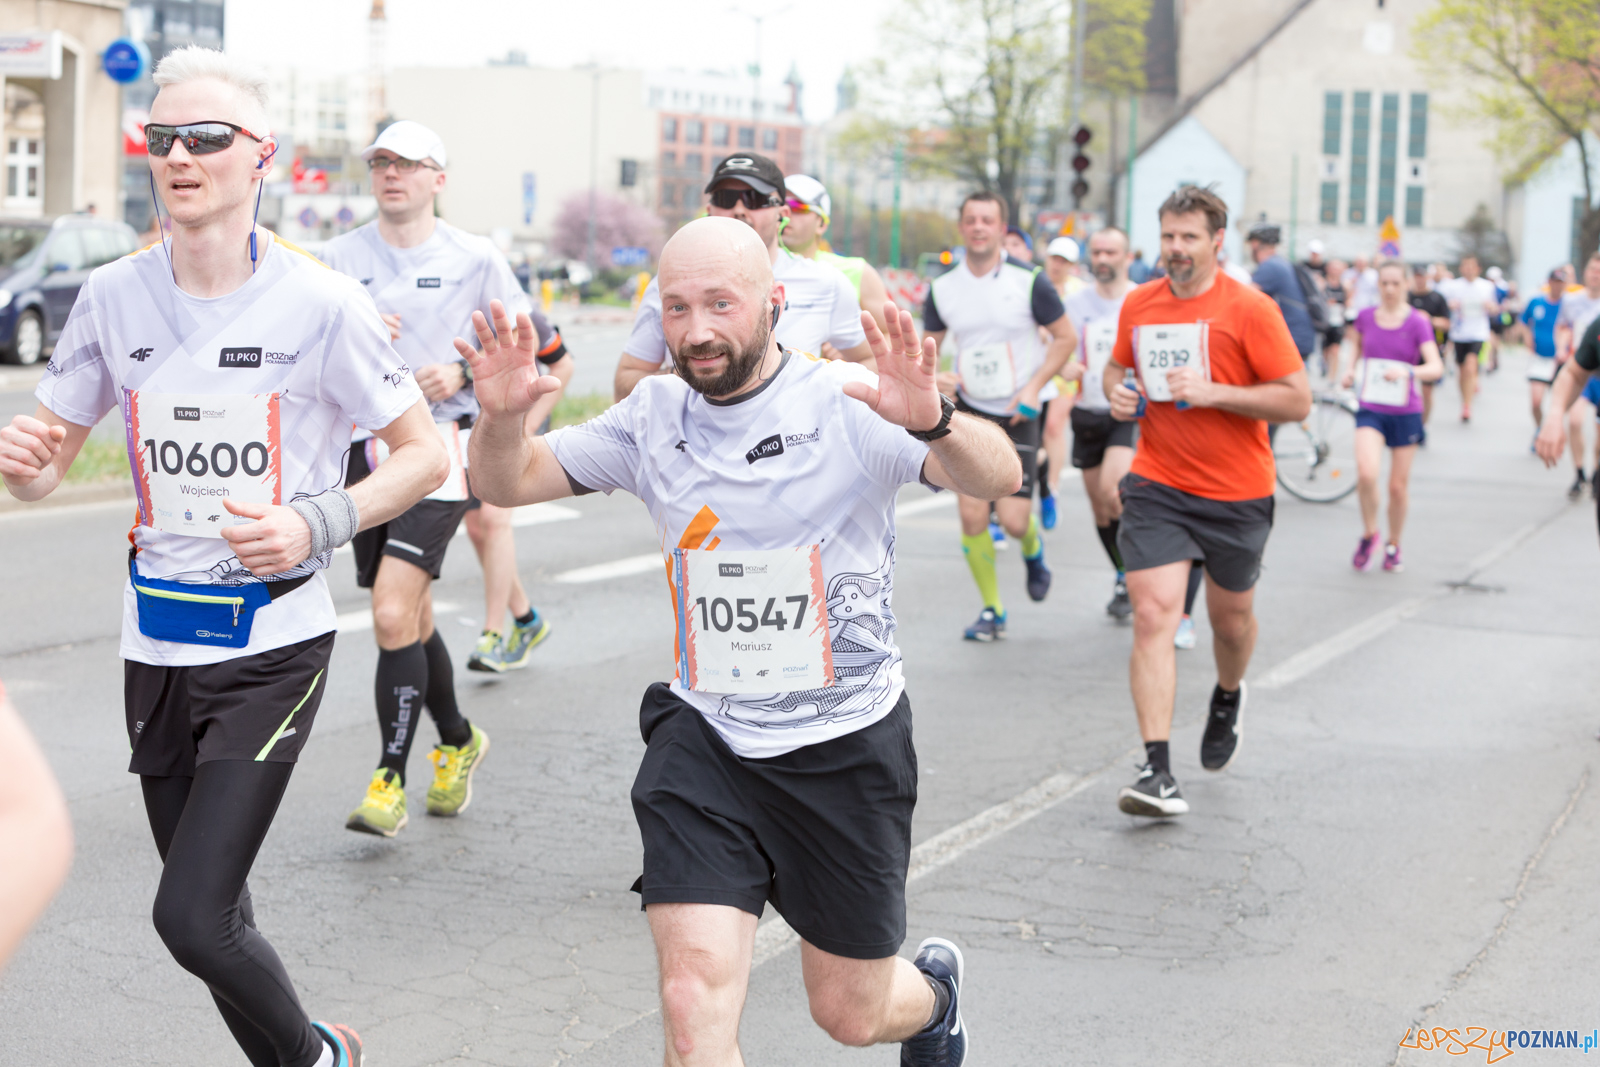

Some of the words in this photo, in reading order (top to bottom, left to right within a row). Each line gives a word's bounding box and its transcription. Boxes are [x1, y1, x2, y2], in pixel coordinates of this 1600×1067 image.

[130, 347, 154, 362] 4F
[225, 353, 235, 362] 11.
[236, 352, 258, 362] PKO
[185, 410, 199, 418] PKO
[750, 449, 762, 458] 11.
[761, 440, 780, 454] PKO
[144, 438, 269, 478] 10600
[180, 484, 230, 498] Wojciech
[728, 566, 742, 574] PKO
[696, 594, 809, 633] 10547
[731, 641, 773, 651] Mariusz
[387, 685, 420, 755] Kalenji
